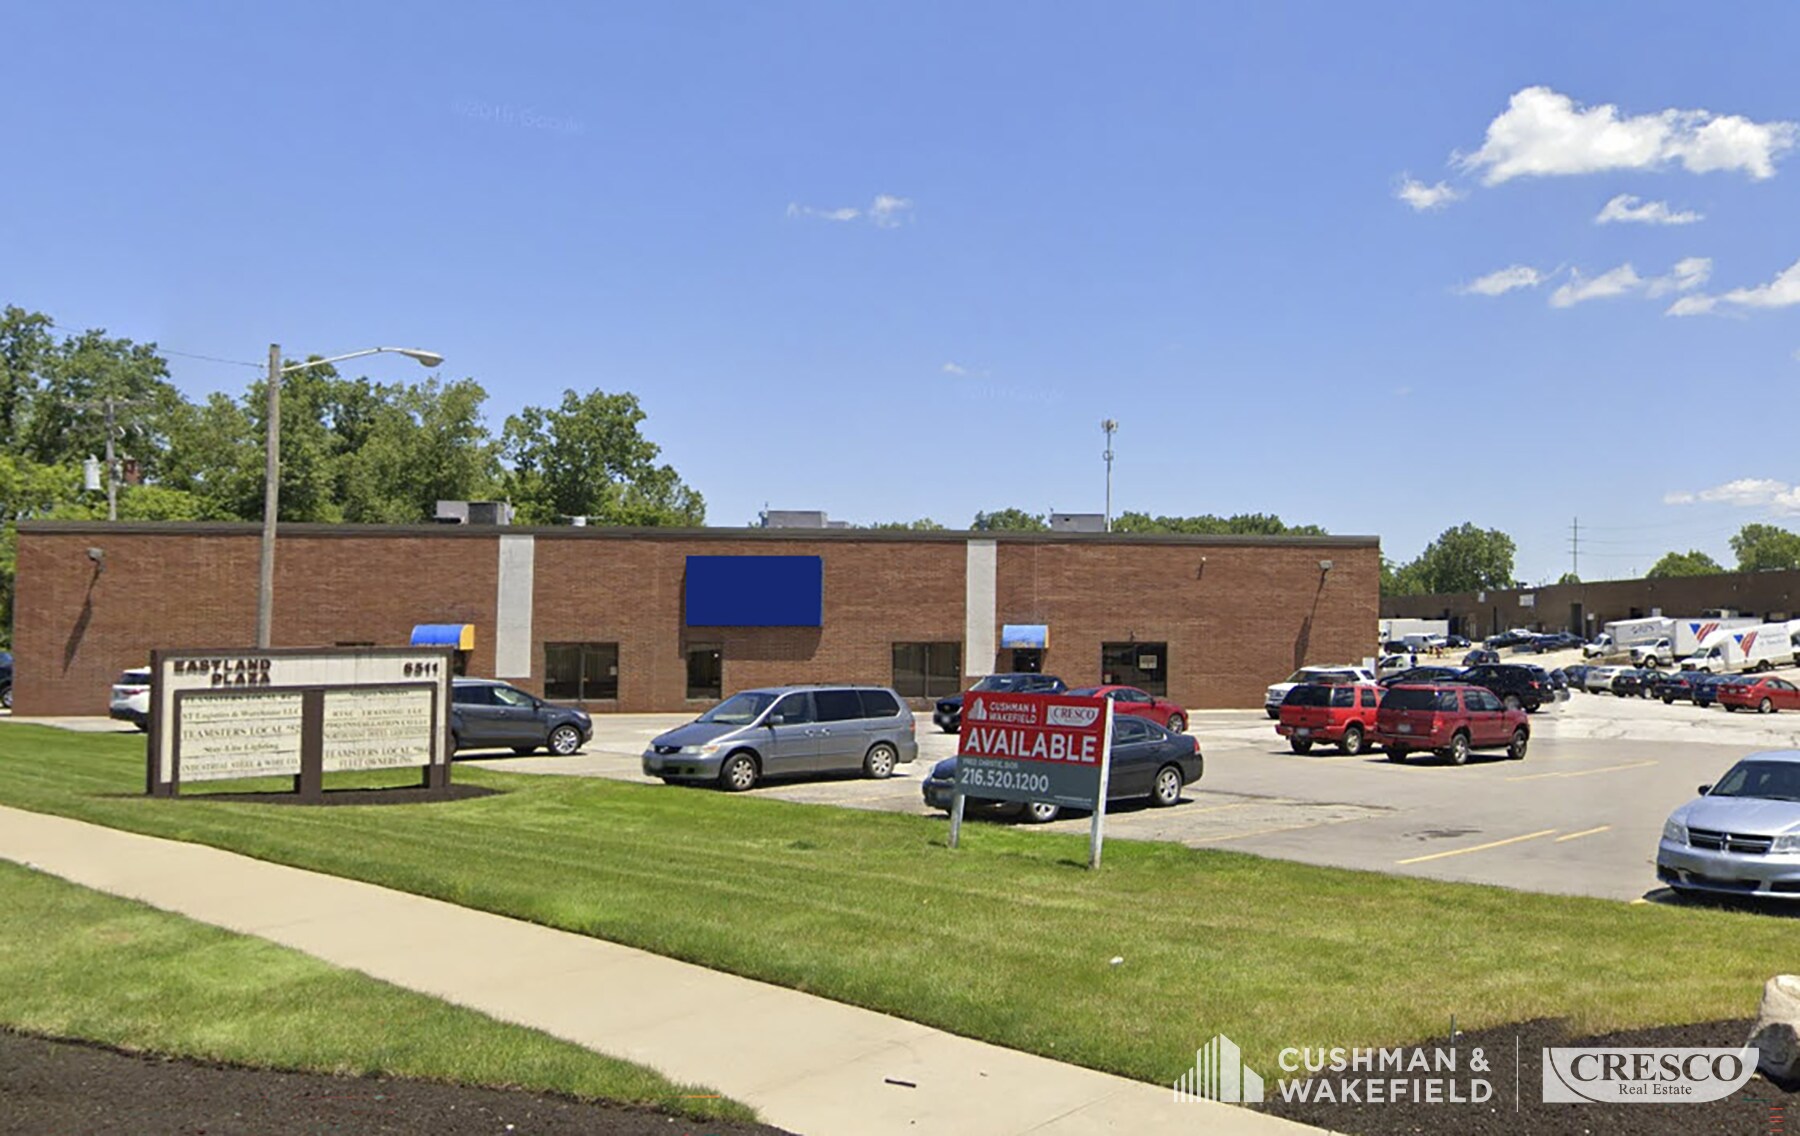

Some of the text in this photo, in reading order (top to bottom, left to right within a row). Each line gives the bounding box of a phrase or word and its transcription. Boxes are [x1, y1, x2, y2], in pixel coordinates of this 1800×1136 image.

[173, 659, 271, 674] EASTLAND
[403, 662, 438, 677] 6511
[211, 673, 271, 686] PLAZA
[989, 702, 1037, 713] CUSHMAN &
[1053, 707, 1096, 720] CRESCO
[989, 712, 1037, 723] WAKEFIELD
[182, 728, 246, 740] TEAMSTERS
[250, 725, 282, 736] LOCAL
[964, 727, 1097, 762] AVAILABLE
[325, 748, 379, 758] TEAMSTERS
[382, 746, 409, 754] LOCAL
[961, 768, 1049, 792] 216.520.1200
